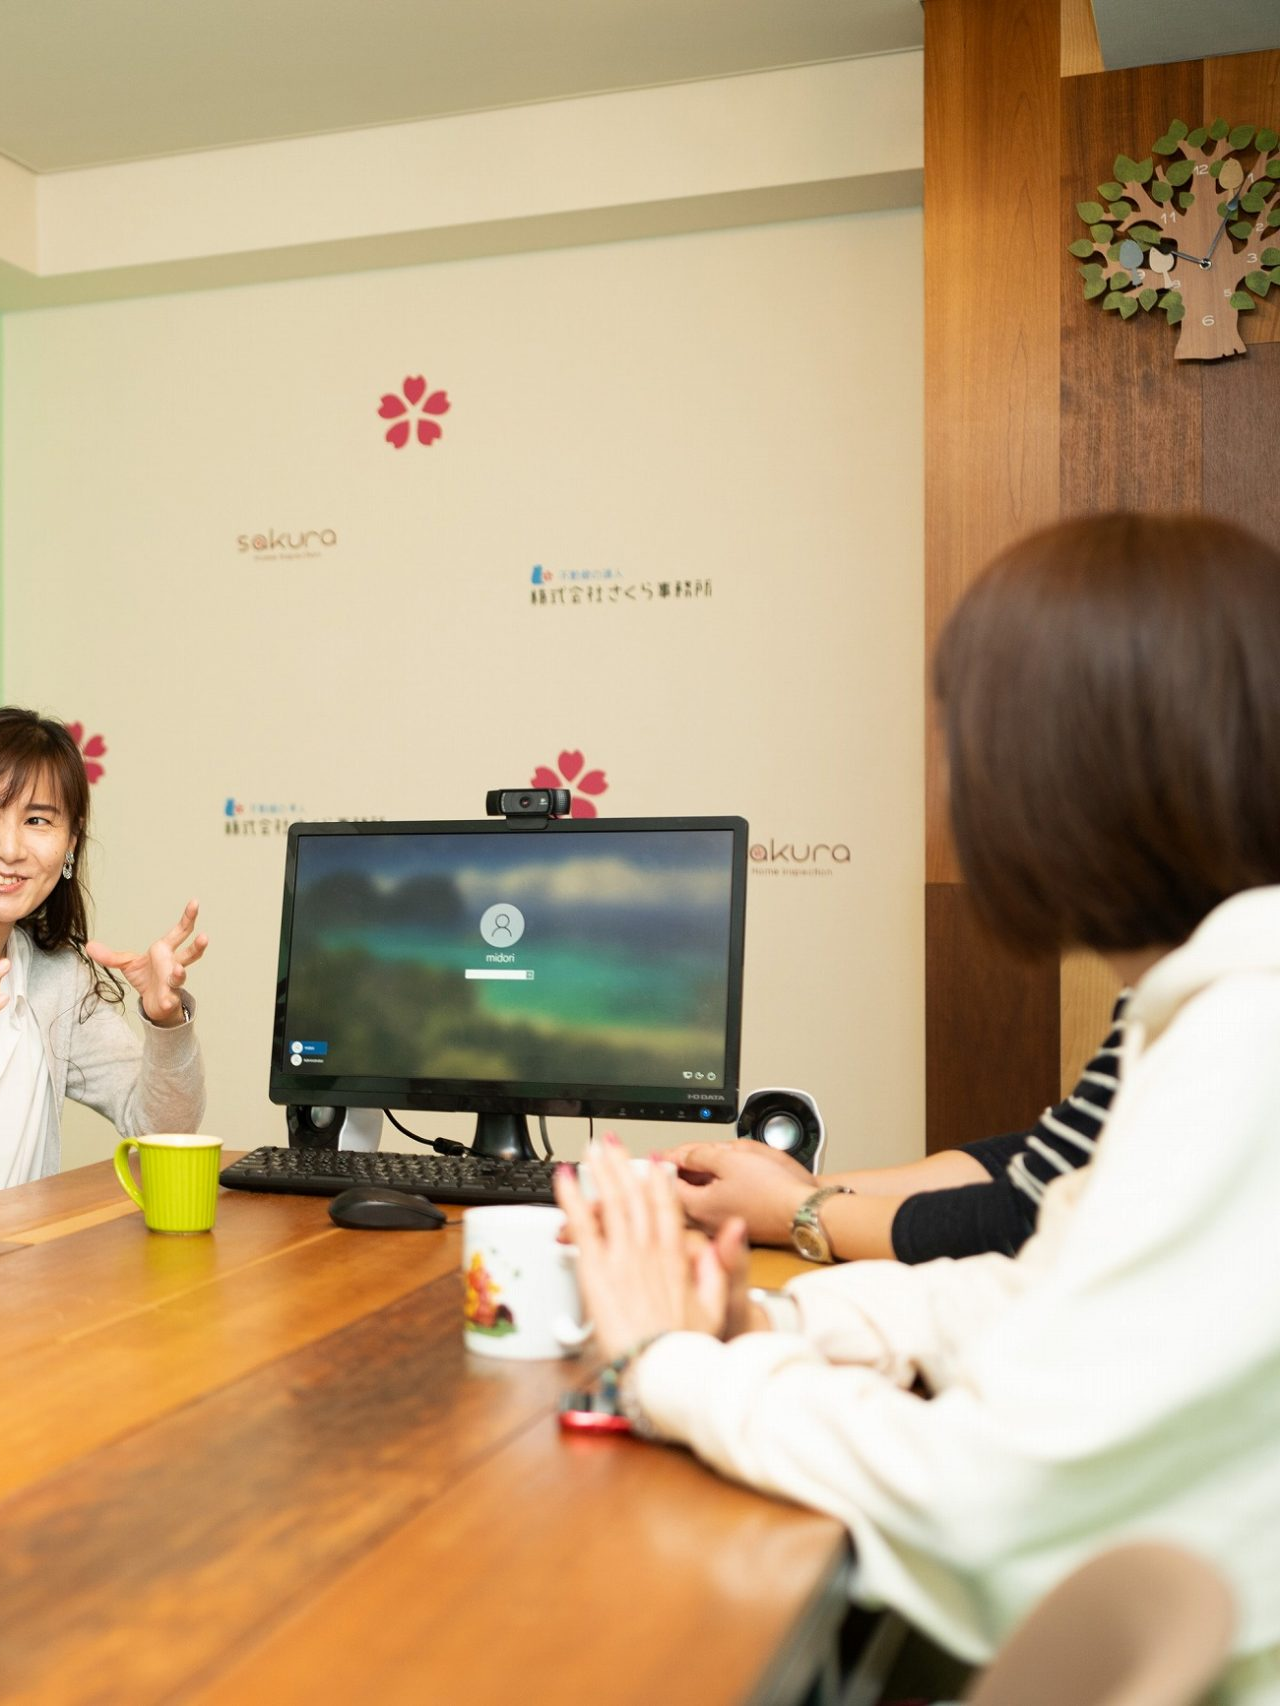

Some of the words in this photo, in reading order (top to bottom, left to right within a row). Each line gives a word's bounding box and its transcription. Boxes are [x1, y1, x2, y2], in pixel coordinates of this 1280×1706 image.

[1194, 164, 1209, 175] 12
[1161, 212, 1177, 225] 11
[1255, 223, 1265, 232] 2
[1246, 253, 1258, 264] 3
[1201, 315, 1215, 327] 6
[237, 527, 337, 552] sakura
[531, 578, 712, 605] 株式会社さくら事務所
[749, 838, 851, 863] akura
[486, 952, 515, 963] midori
